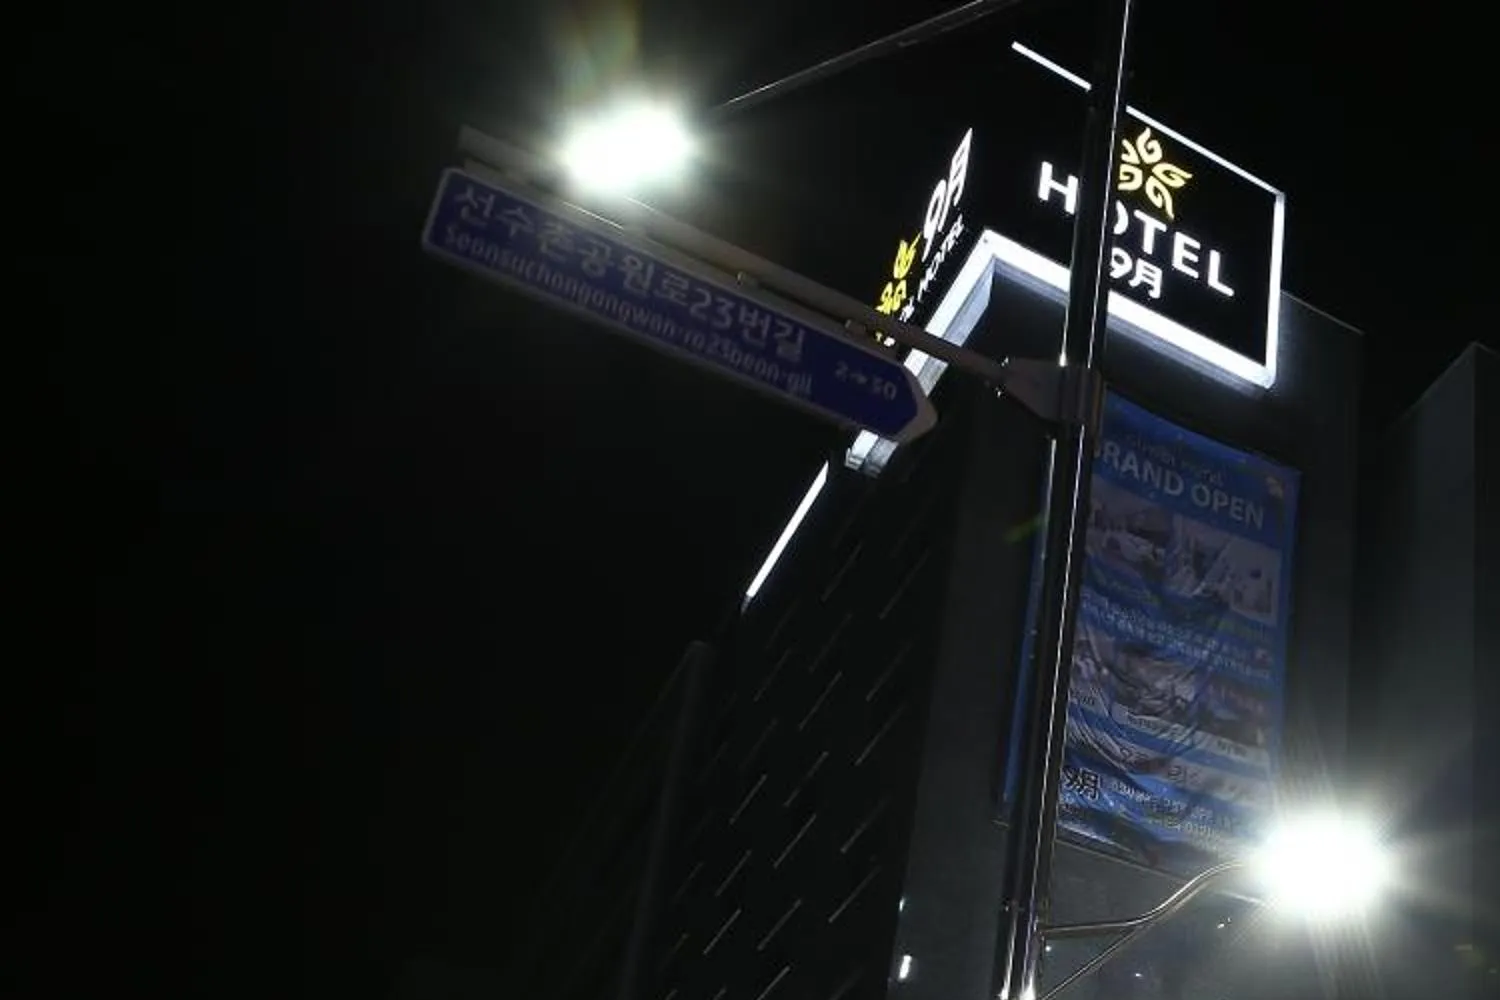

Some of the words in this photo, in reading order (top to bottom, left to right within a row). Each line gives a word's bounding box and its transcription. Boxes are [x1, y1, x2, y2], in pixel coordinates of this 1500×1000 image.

[453, 184, 805, 363] 선수촌공원로23번길
[1096, 441, 1184, 496] RAND
[1191, 484, 1265, 530] OPEN
